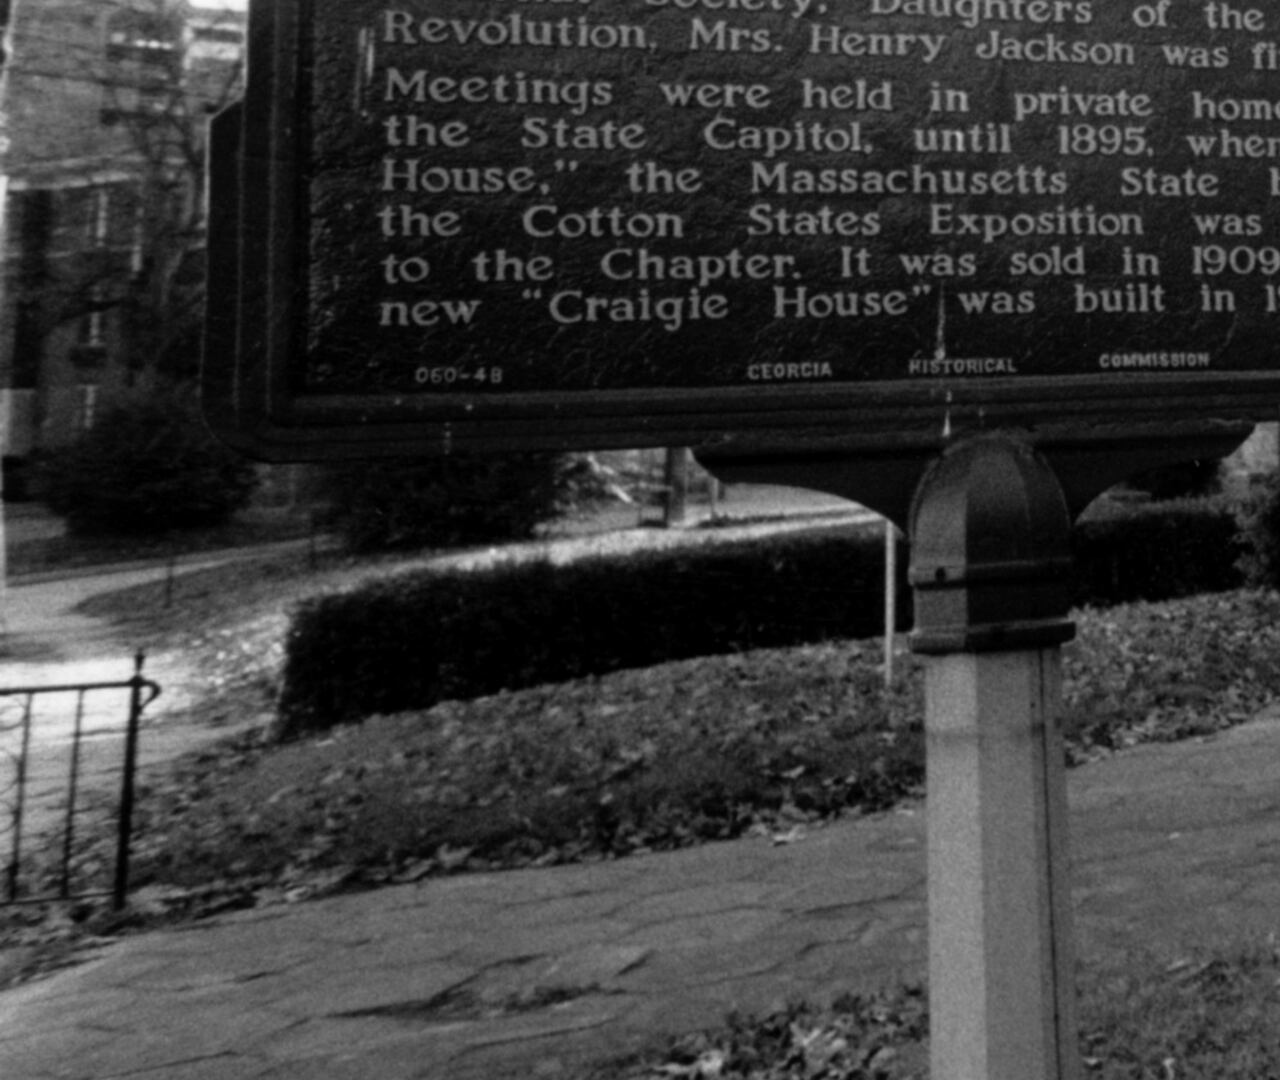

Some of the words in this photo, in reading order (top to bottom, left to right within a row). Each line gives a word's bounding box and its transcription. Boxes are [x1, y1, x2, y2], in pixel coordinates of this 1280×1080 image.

[1203, 1, 1265, 32] the
[690, 17, 783, 52] Mrs.
[810, 23, 946, 63] Henry
[975, 29, 1134, 65] Jackson
[1161, 44, 1229, 68] was
[385, 67, 613, 115] Meetings
[660, 83, 770, 109] were
[802, 78, 892, 110] held
[930, 81, 969, 112] in
[1014, 85, 1152, 122] private
[383, 114, 469, 147] the
[521, 117, 646, 150] State
[914, 122, 1011, 153] until
[1058, 123, 1154, 156] 1895,
[625, 161, 702, 193] the
[751, 161, 1068, 195] Massachusetts
[1120, 167, 1218, 197] State
[377, 204, 461, 237] the
[522, 204, 683, 238] Cotton
[747, 203, 881, 236] States
[930, 203, 1144, 243] Exposition
[1194, 214, 1262, 236] was
[381, 254, 429, 284] to
[472, 249, 553, 282] the
[600, 247, 801, 287] Chapter.
[841, 245, 870, 278] It
[899, 253, 977, 277] was
[1009, 245, 1085, 276] sold
[1122, 246, 1159, 276] in
[380, 299, 481, 326] new
[958, 290, 1036, 314] was
[1074, 283, 1165, 313] built
[1200, 283, 1236, 312] in
[747, 361, 832, 380] GEORGIA
[908, 357, 1017, 374] HISTORICAL
[1099, 352, 1210, 368] COMMISSION
